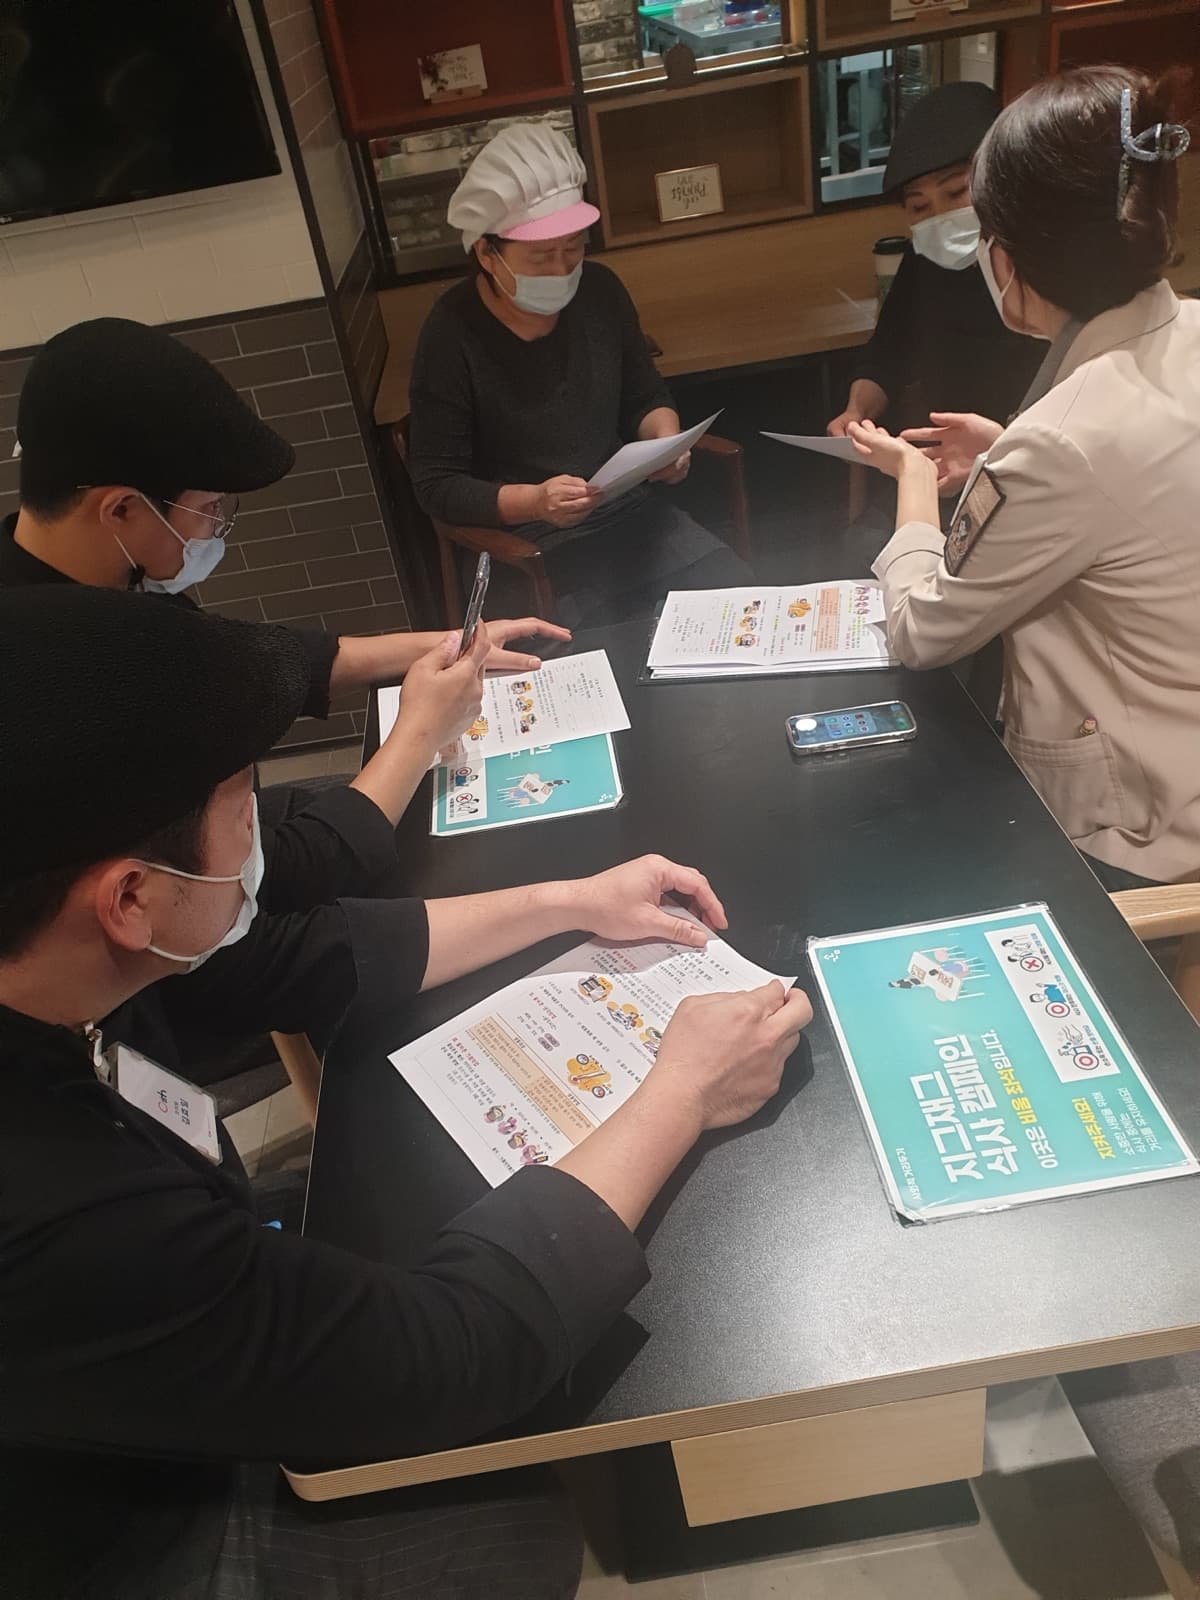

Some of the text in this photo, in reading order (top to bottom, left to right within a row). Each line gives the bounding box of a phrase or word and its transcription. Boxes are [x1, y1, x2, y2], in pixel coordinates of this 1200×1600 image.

[910, 1071, 984, 1183] 지그재그
[934, 1034, 1020, 1175] 식사 캠페인
[981, 1029, 1059, 1169] 이곳은 비움 좌석입니다.
[1071, 1097, 1117, 1160] 지켜주세요!
[1090, 1091, 1107, 1108] 위해
[1116, 1087, 1163, 1152] 거리를 유지하세요!
[895, 1147, 914, 1178] 거리두기
[1113, 1131, 1135, 1156] 소중한
[1119, 1112, 1147, 1154] 식사 중에는
